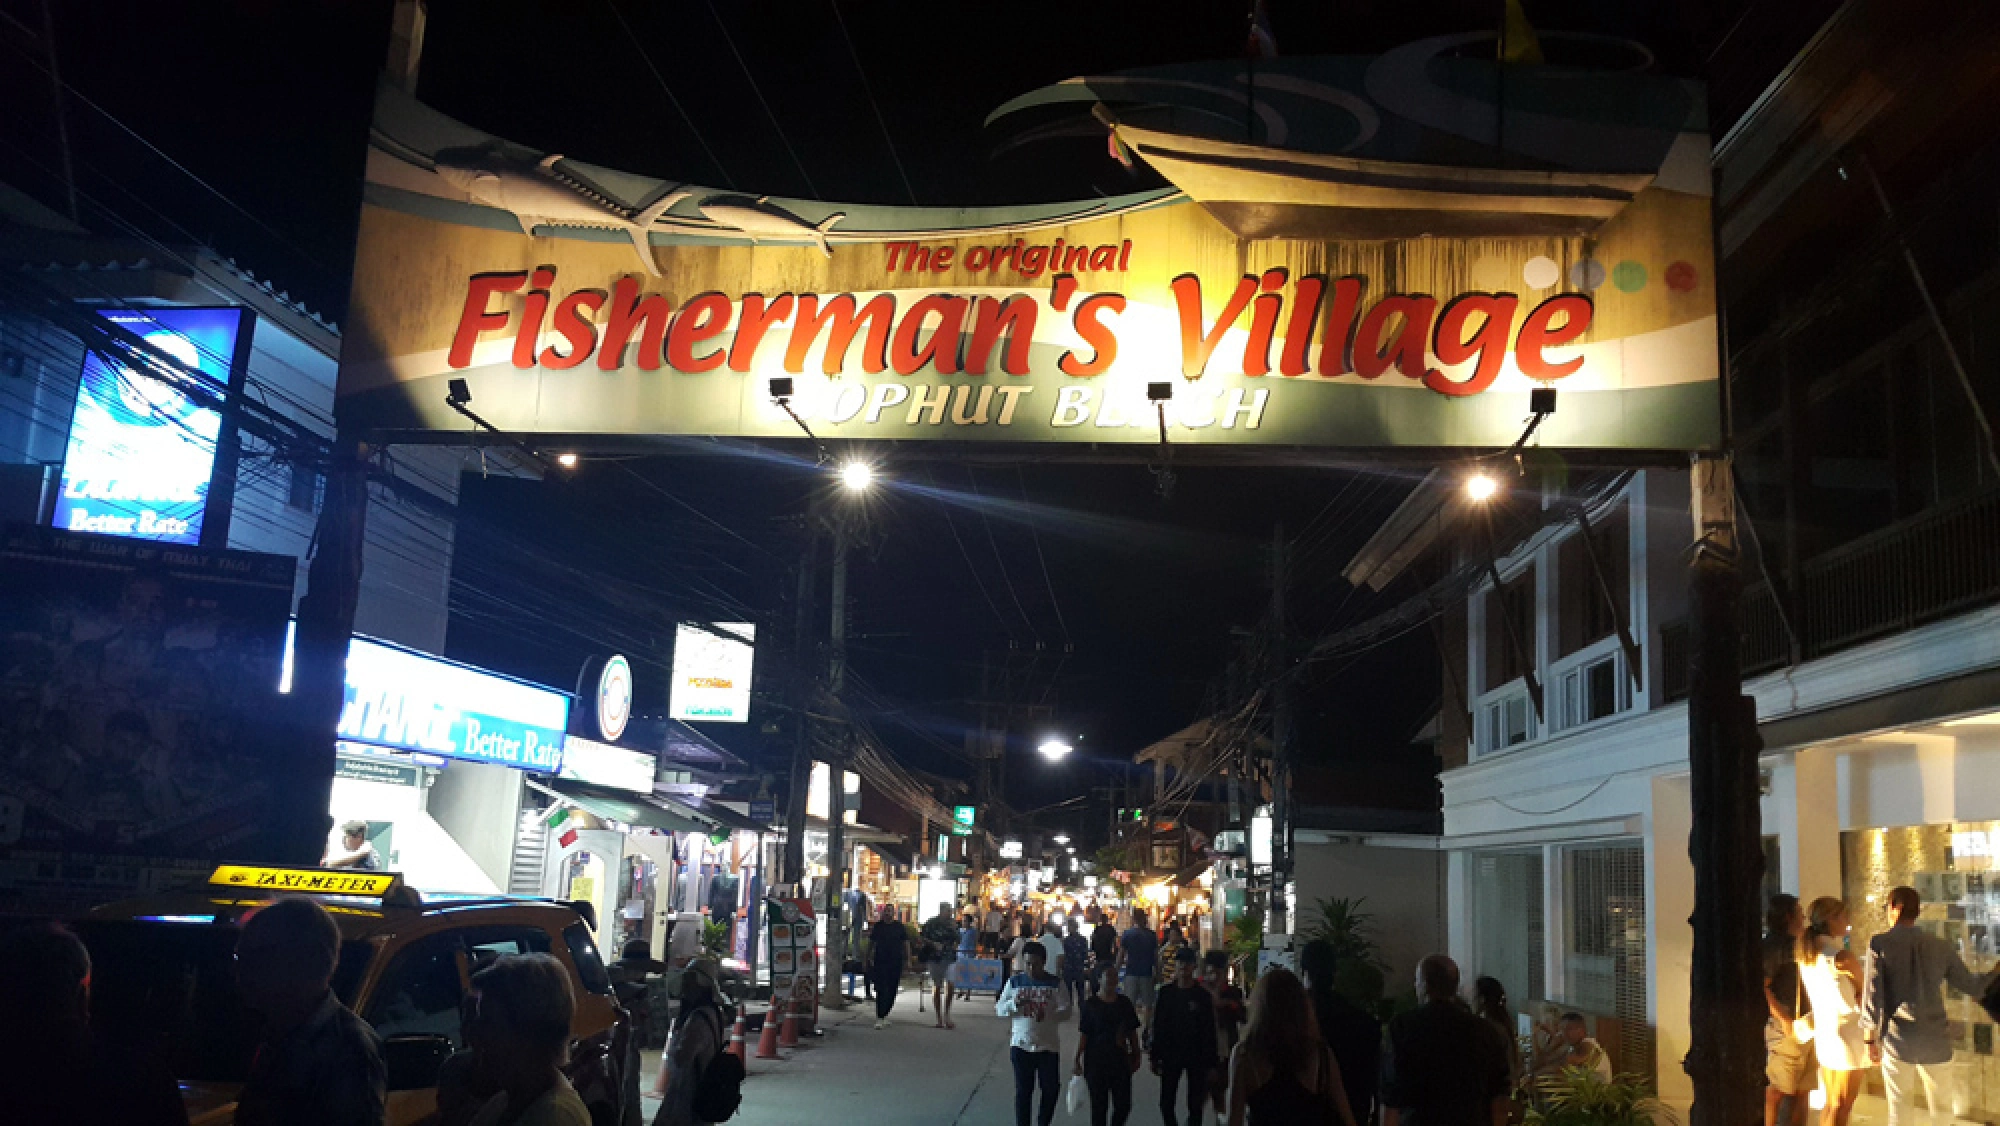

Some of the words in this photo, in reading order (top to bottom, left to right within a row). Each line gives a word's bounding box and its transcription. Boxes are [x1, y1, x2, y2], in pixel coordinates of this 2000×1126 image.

[886, 241, 955, 272] The
[965, 238, 1132, 278] original
[448, 265, 1126, 376] Fisherman's
[1171, 267, 1593, 396] Village
[780, 384, 1034, 426] OPHUT
[1050, 385, 1271, 430] BECH
[68, 507, 136, 532] Better
[137, 509, 189, 534] Rate
[54, 537, 82, 551] THE
[135, 548, 157, 561] OF
[218, 557, 252, 573] THAI
[464, 717, 520, 762] Better
[255, 872, 377, 892] TAXI-METER
